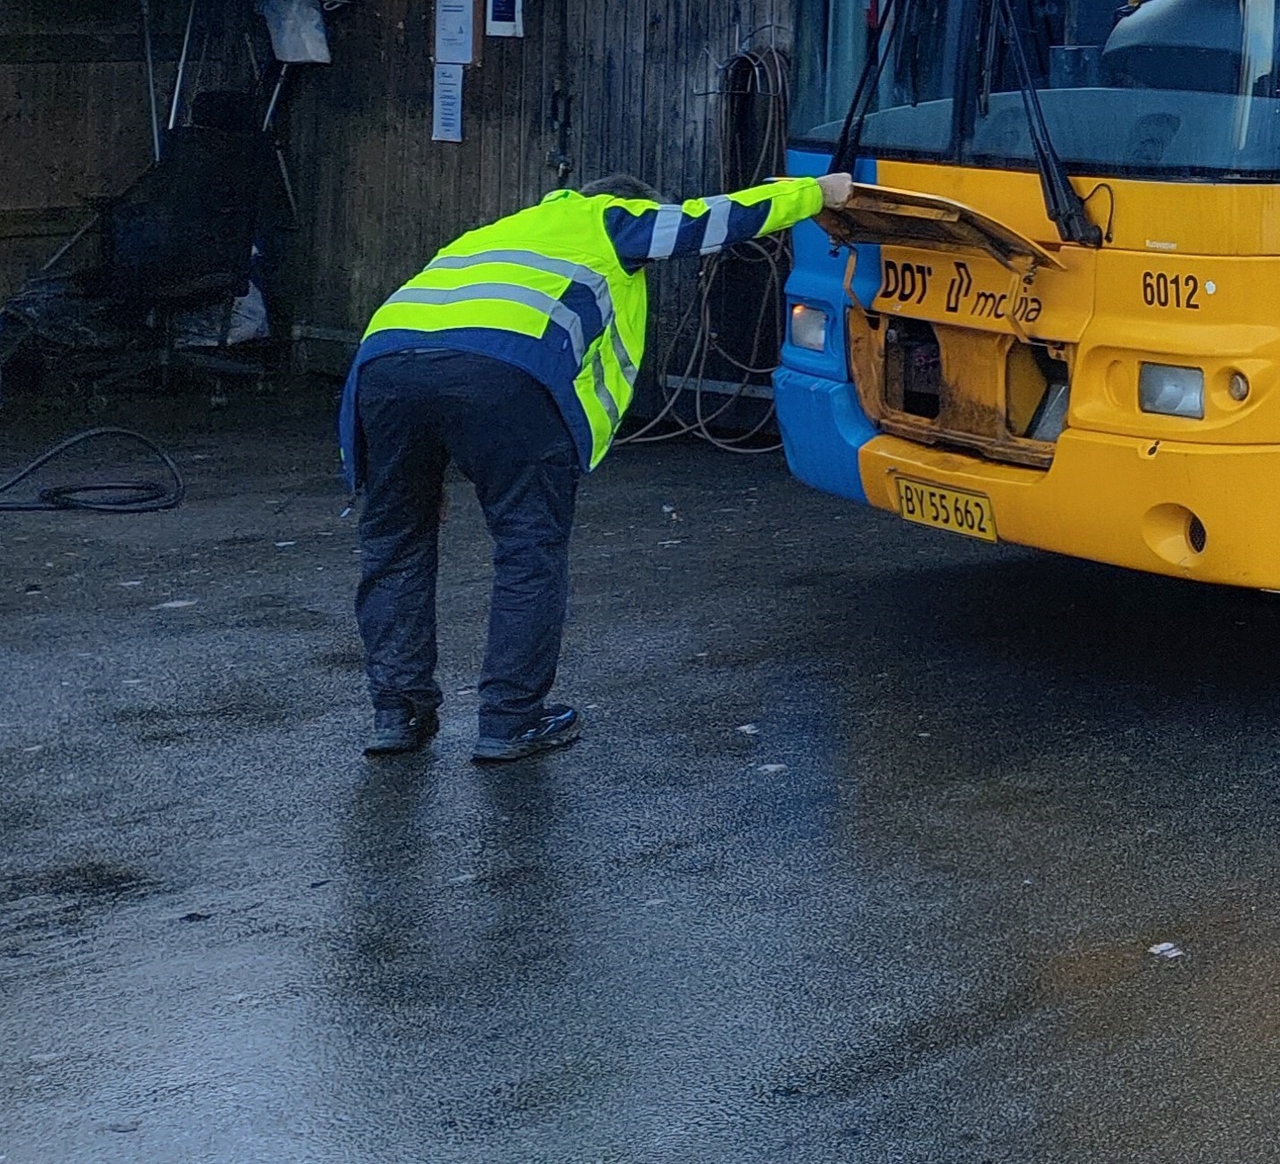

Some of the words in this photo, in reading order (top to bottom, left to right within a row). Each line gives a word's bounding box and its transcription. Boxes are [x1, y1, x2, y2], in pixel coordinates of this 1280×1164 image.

[1142, 270, 1200, 310] 6012
[904, 484, 925, 519] BY
[928, 490, 951, 525] 55
[953, 496, 988, 534] 662
